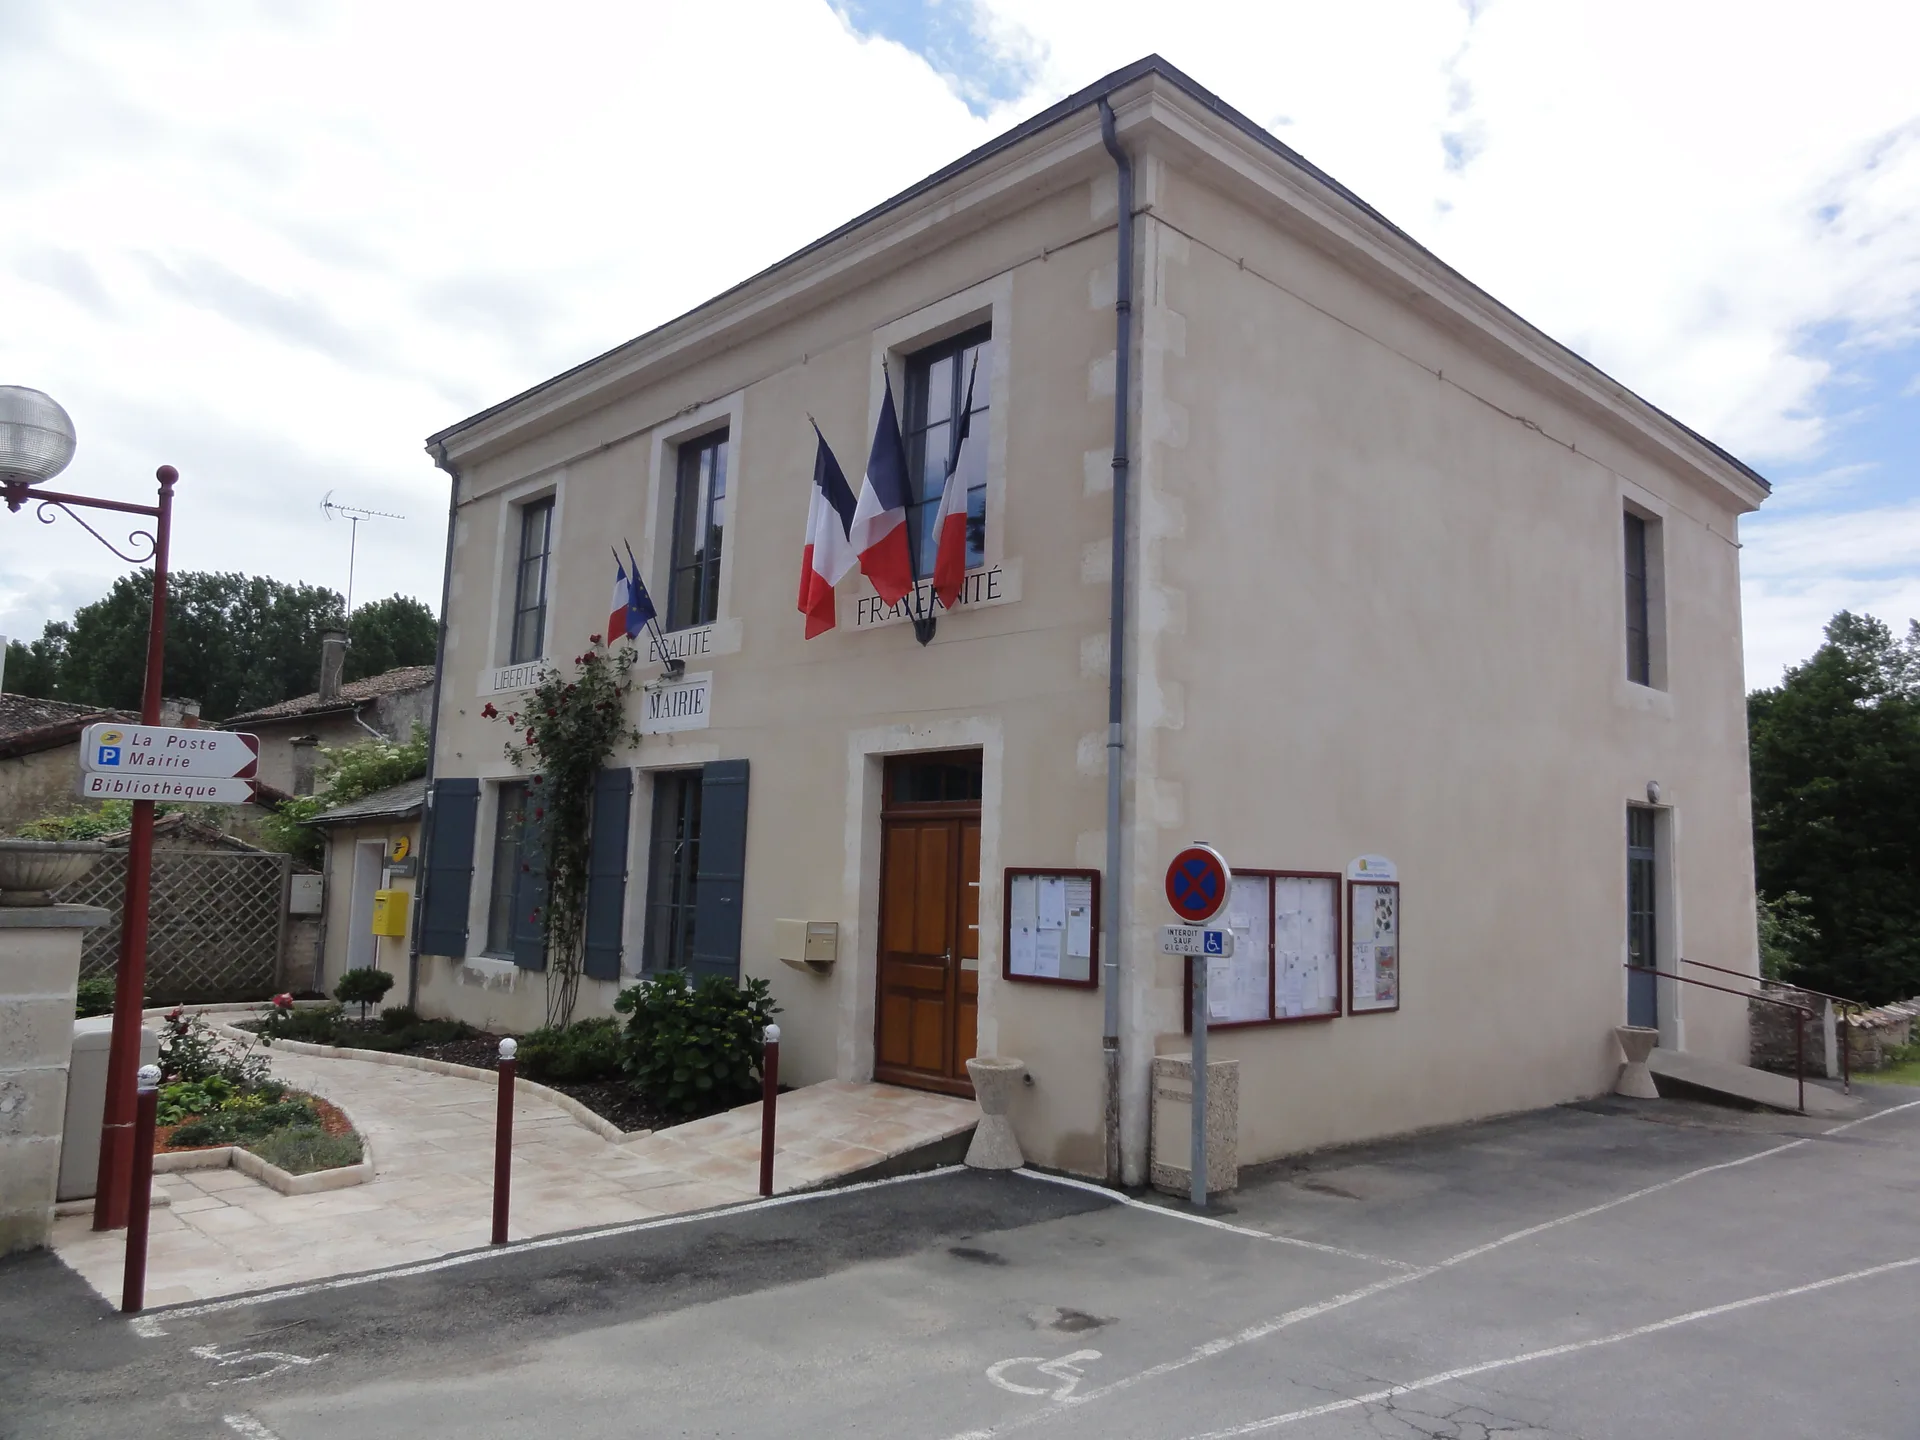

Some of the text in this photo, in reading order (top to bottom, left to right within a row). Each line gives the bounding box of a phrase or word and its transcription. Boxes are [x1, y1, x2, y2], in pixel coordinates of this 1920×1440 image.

[649, 688, 705, 719] MAIRIE
[131, 733, 217, 751] La Poste
[128, 752, 190, 768] Mairie
[91, 778, 217, 798] Bibliothèque
[1167, 929, 1198, 937] INTERDIT
